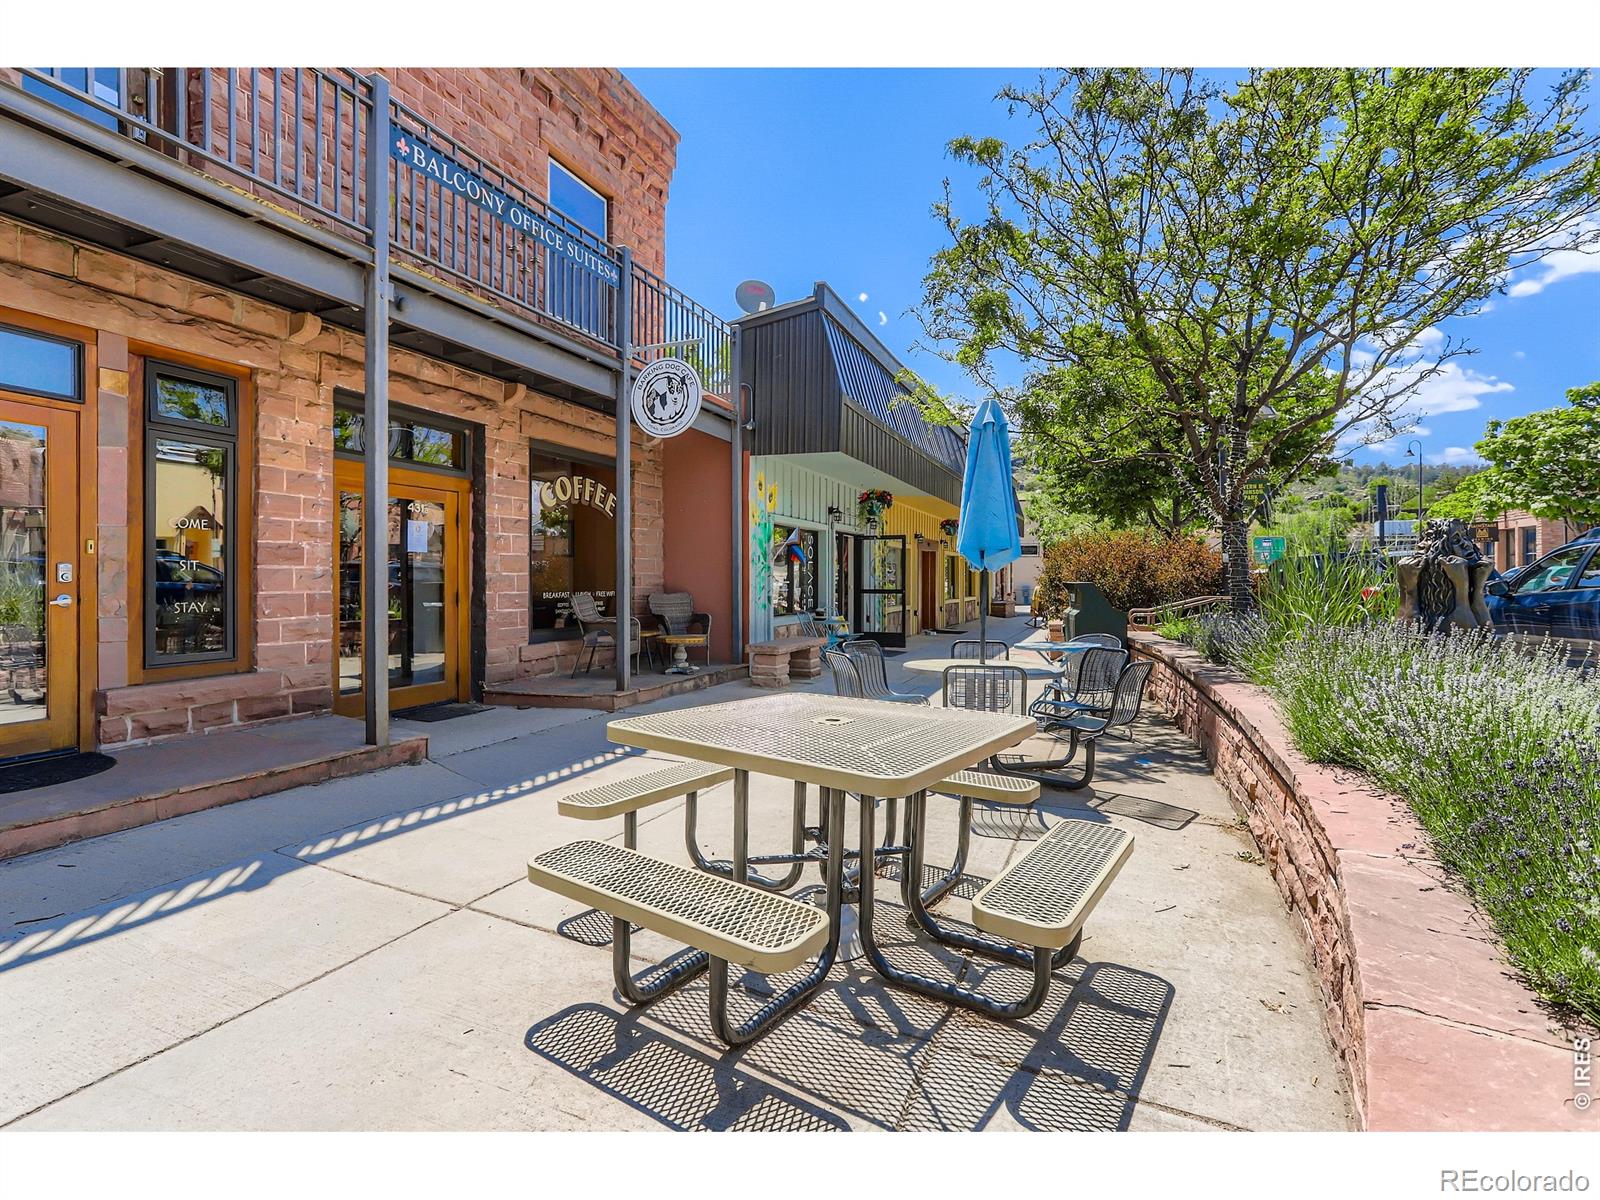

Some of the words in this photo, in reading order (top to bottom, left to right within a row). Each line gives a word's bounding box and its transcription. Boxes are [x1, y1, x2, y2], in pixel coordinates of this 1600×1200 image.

[411, 144, 505, 215] BALCONY
[510, 207, 564, 252] OFFICE
[567, 242, 611, 280] SUITES
[638, 364, 663, 390] BARKING
[665, 363, 681, 371] DOG
[680, 368, 696, 388] CAFE
[541, 476, 617, 517] COFFEE
[542, 591, 570, 599] BREAKFAST
